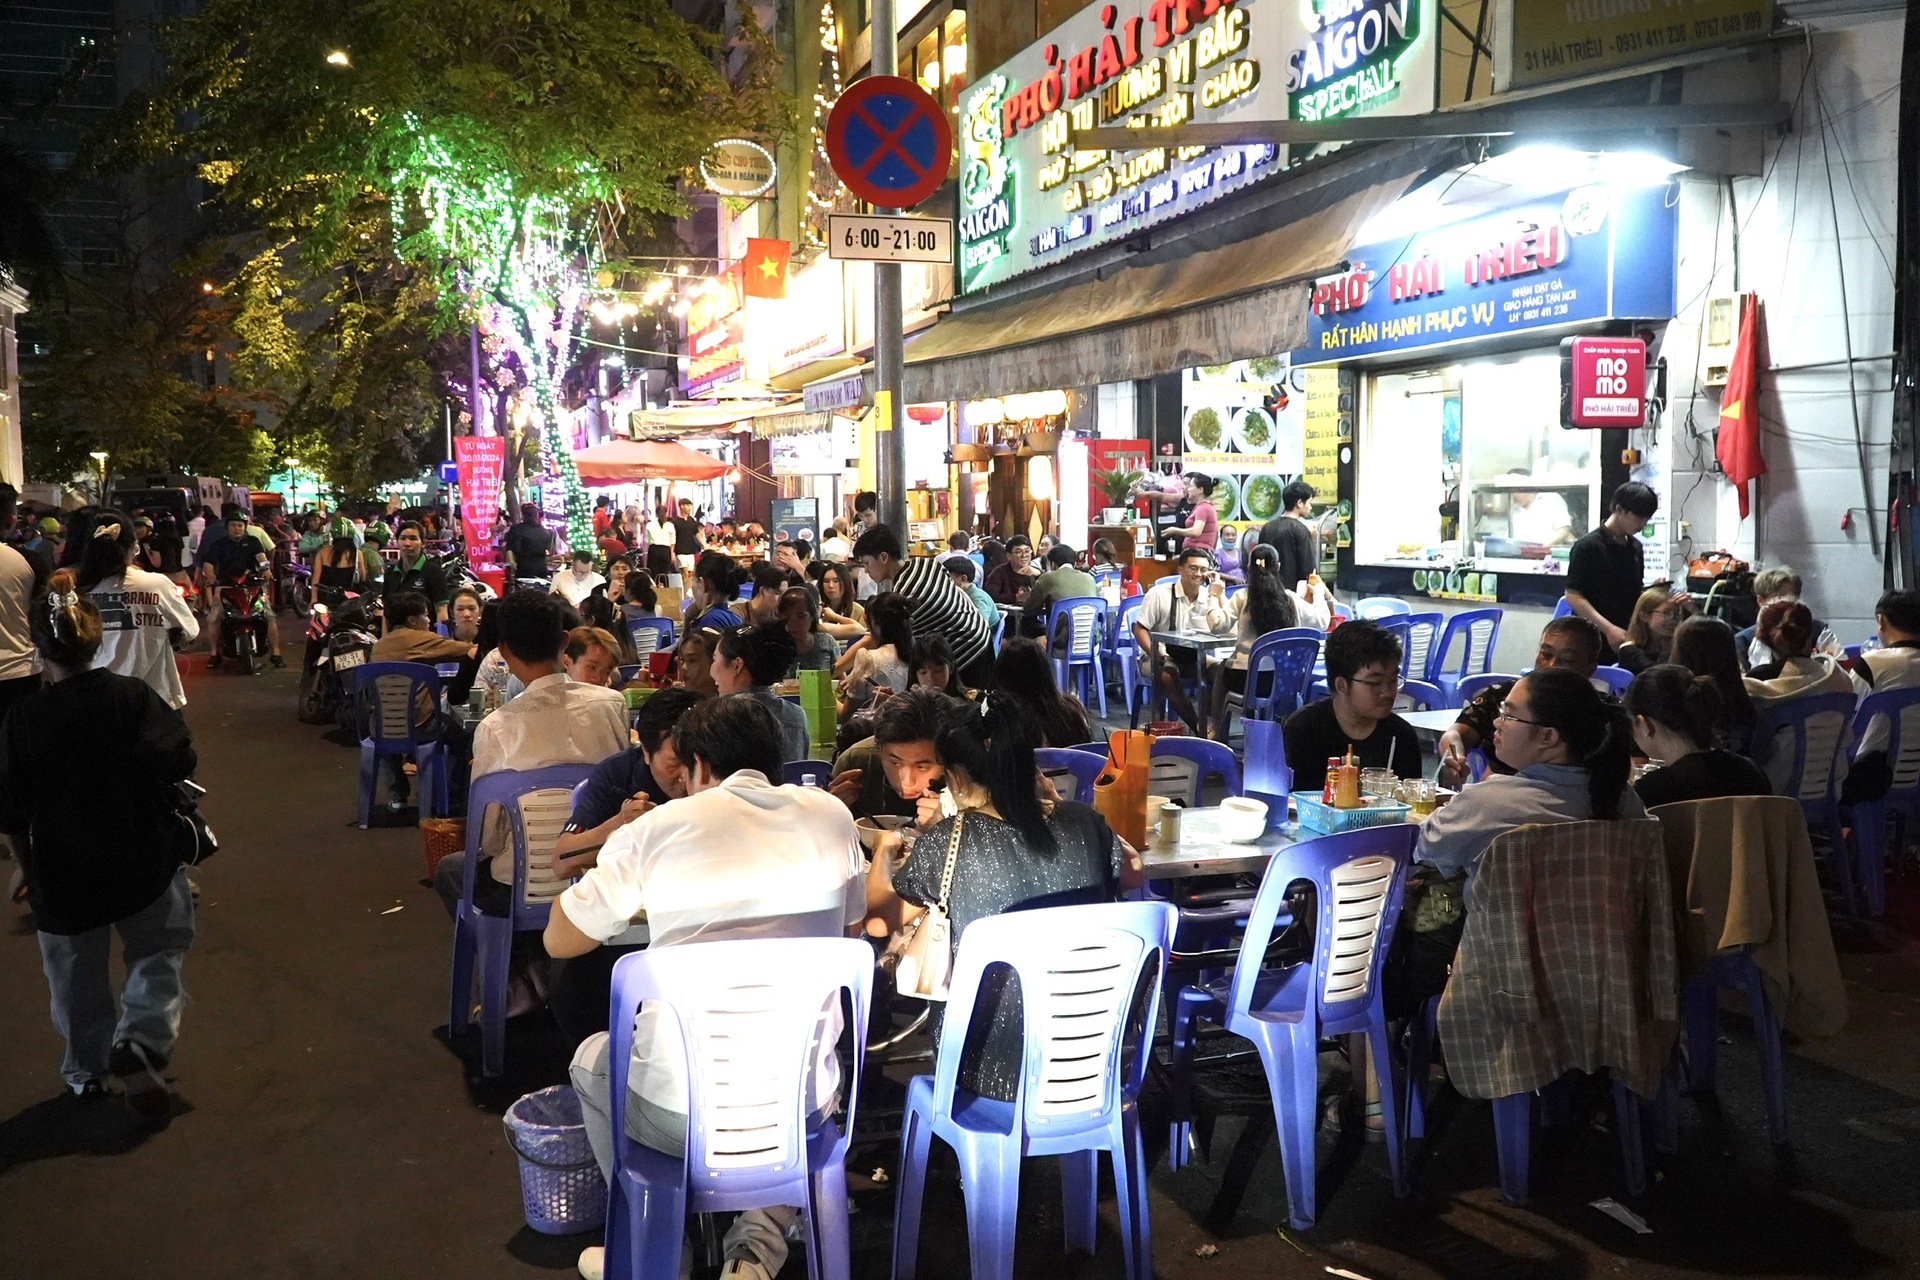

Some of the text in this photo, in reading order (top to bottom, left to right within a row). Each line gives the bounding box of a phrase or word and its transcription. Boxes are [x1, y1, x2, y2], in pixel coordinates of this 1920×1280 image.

[1002, 43, 1062, 138] PHỞ
[1068, 5, 1141, 99] HẢI
[1101, 58, 1161, 121] HƯƠNG
[1169, 39, 1193, 83] VỊ
[1199, 6, 1243, 68] BẮC
[1286, 0, 1408, 93] SAIGON
[1525, 51, 1538, 70] 31
[1615, 33, 1642, 54] 0931
[1202, 60, 1253, 107] CHÁO
[1299, 58, 1395, 121] SPECIAL
[959, 199, 1010, 243] SAIGON
[1313, 261, 1375, 316] PHỞ
[1389, 248, 1446, 301] HẢI
[1321, 300, 1495, 351] RẤT HÂN HẠNH PHỤC VỤ
[124, 591, 160, 606] BRAND
[135, 612, 164, 627] STYLE
